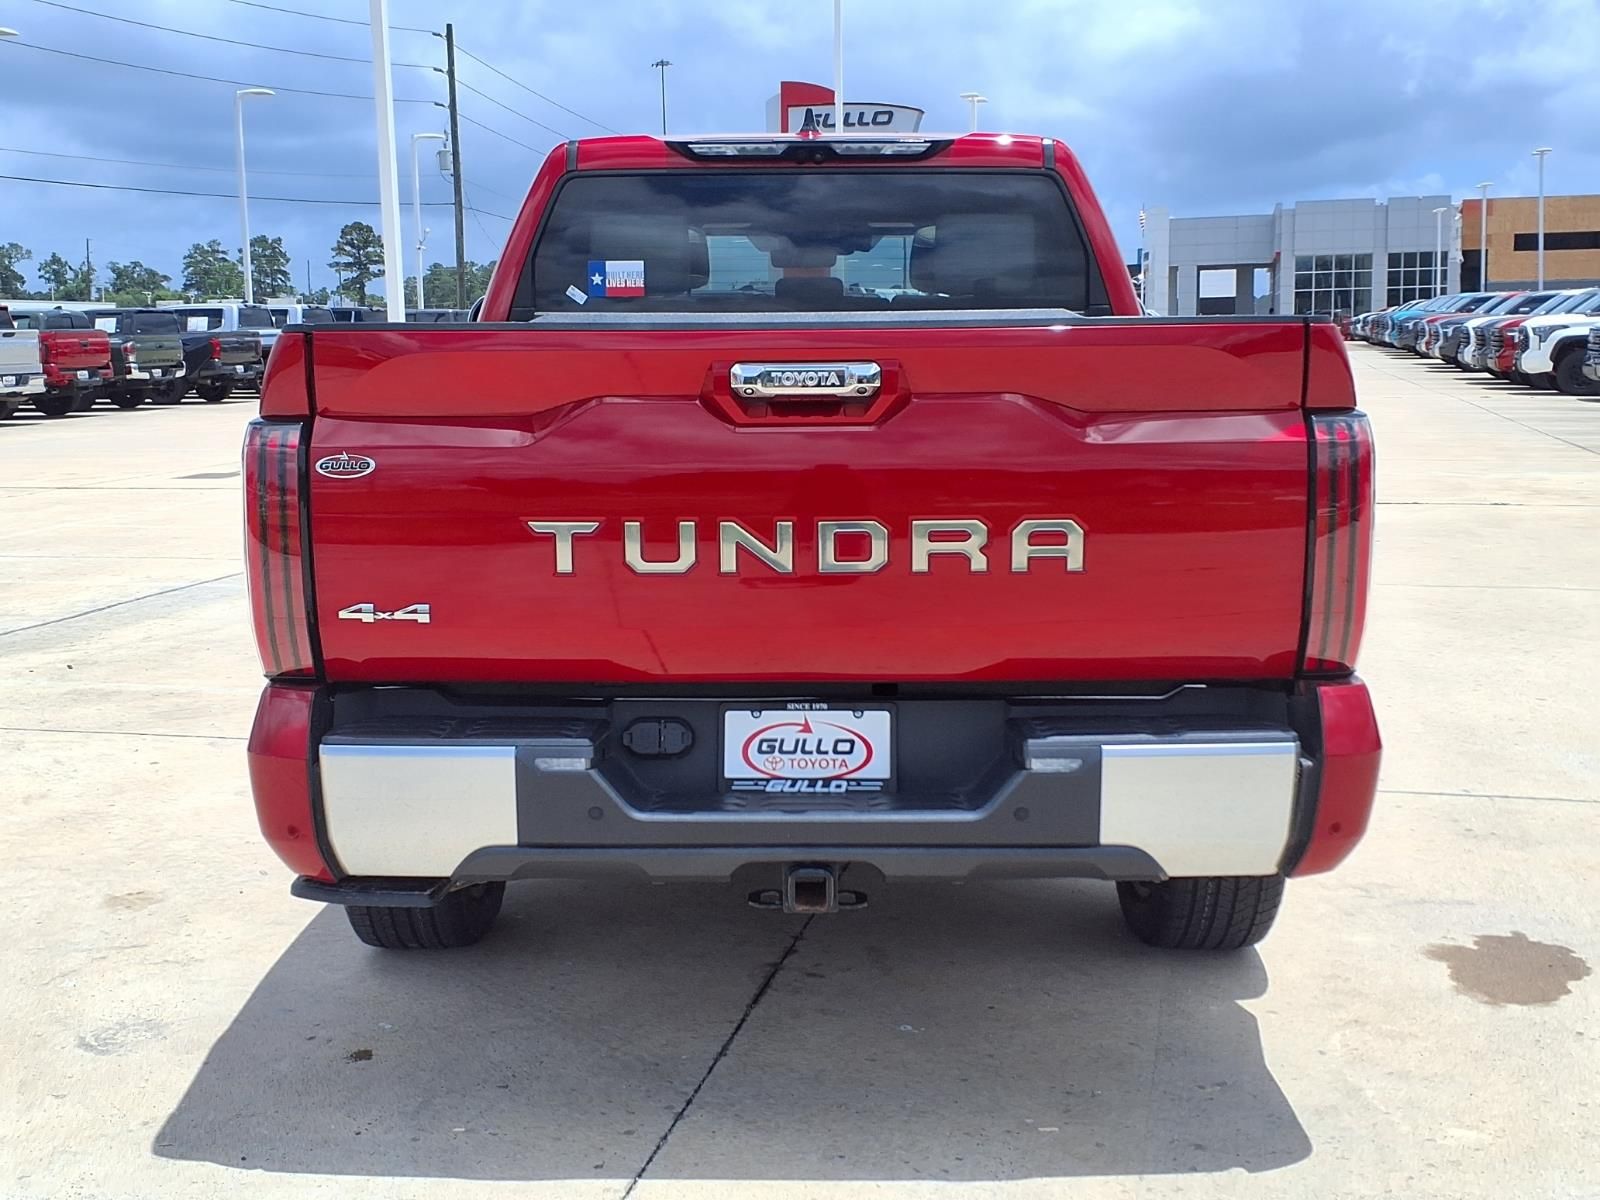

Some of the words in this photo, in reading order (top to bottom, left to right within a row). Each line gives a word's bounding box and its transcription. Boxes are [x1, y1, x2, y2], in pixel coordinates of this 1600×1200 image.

[606, 279, 625, 287] LIVES
[627, 279, 644, 287] HERE
[771, 372, 840, 386] TOYOTA
[319, 461, 371, 471] GULLO
[527, 519, 1085, 574] TUNDRA
[338, 603, 431, 623] 4x4
[757, 738, 856, 755] GULLO
[788, 758, 849, 769] TOYOTA
[765, 780, 848, 793] GULLO
